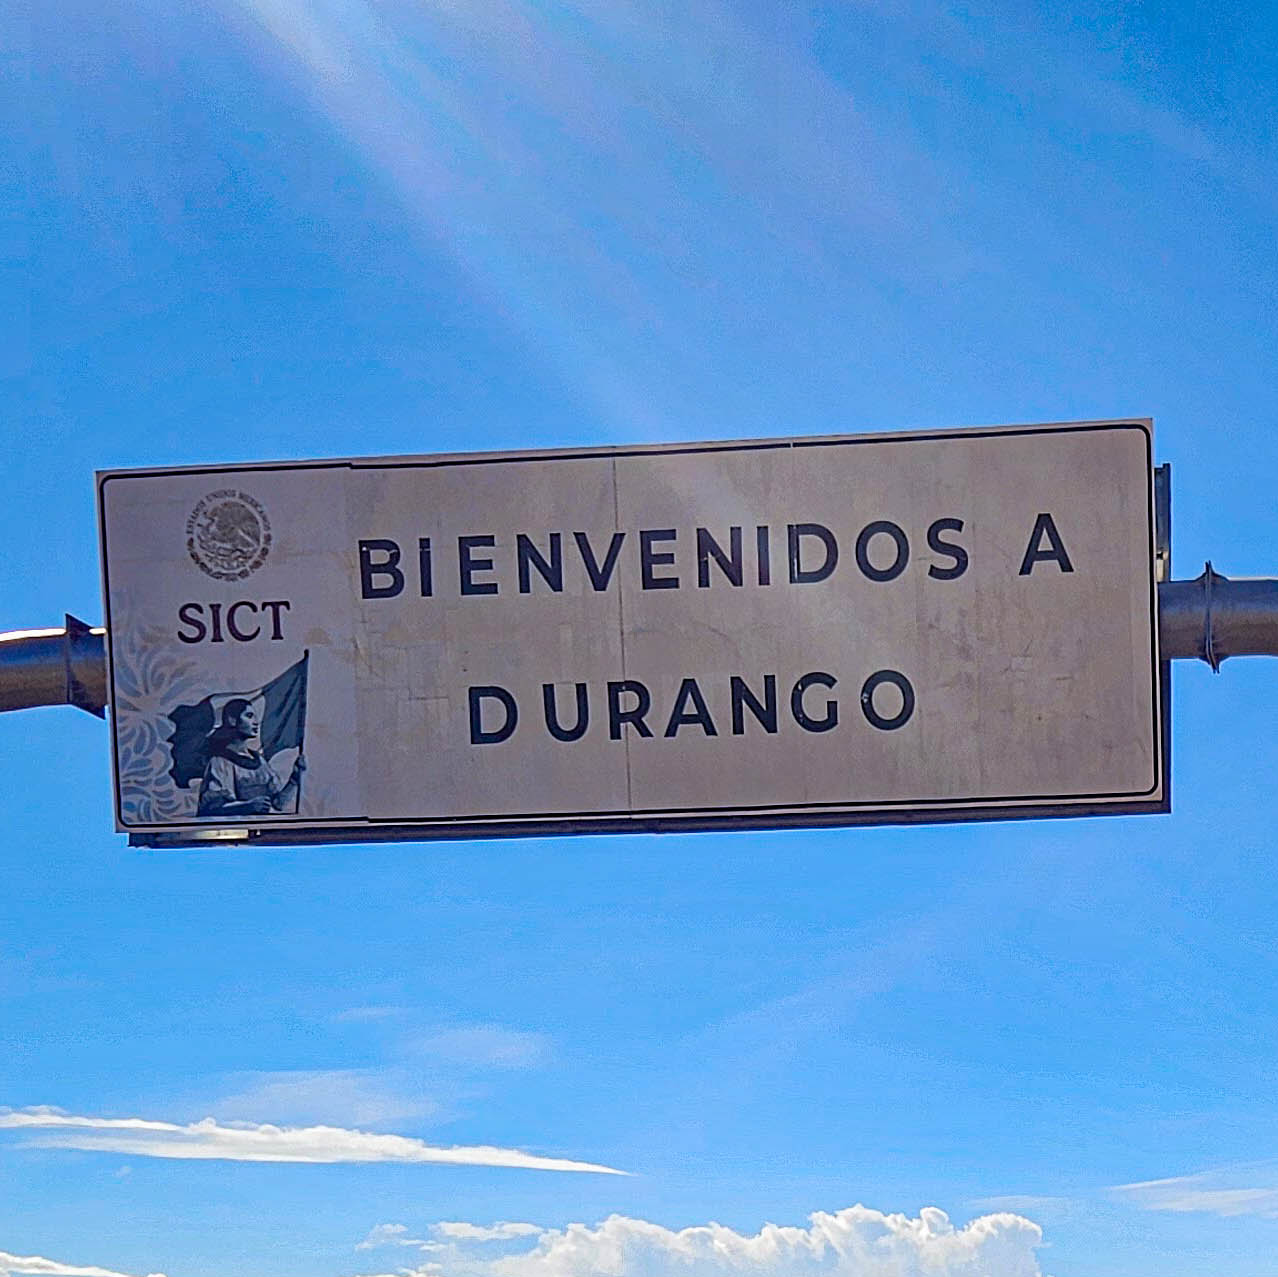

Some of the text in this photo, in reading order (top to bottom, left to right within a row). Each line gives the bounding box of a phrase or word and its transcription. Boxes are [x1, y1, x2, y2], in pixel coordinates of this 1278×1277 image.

[358, 512, 1075, 600] BIENVENIDOS A
[176, 600, 291, 643] SICT
[467, 669, 916, 745] DURANGO
